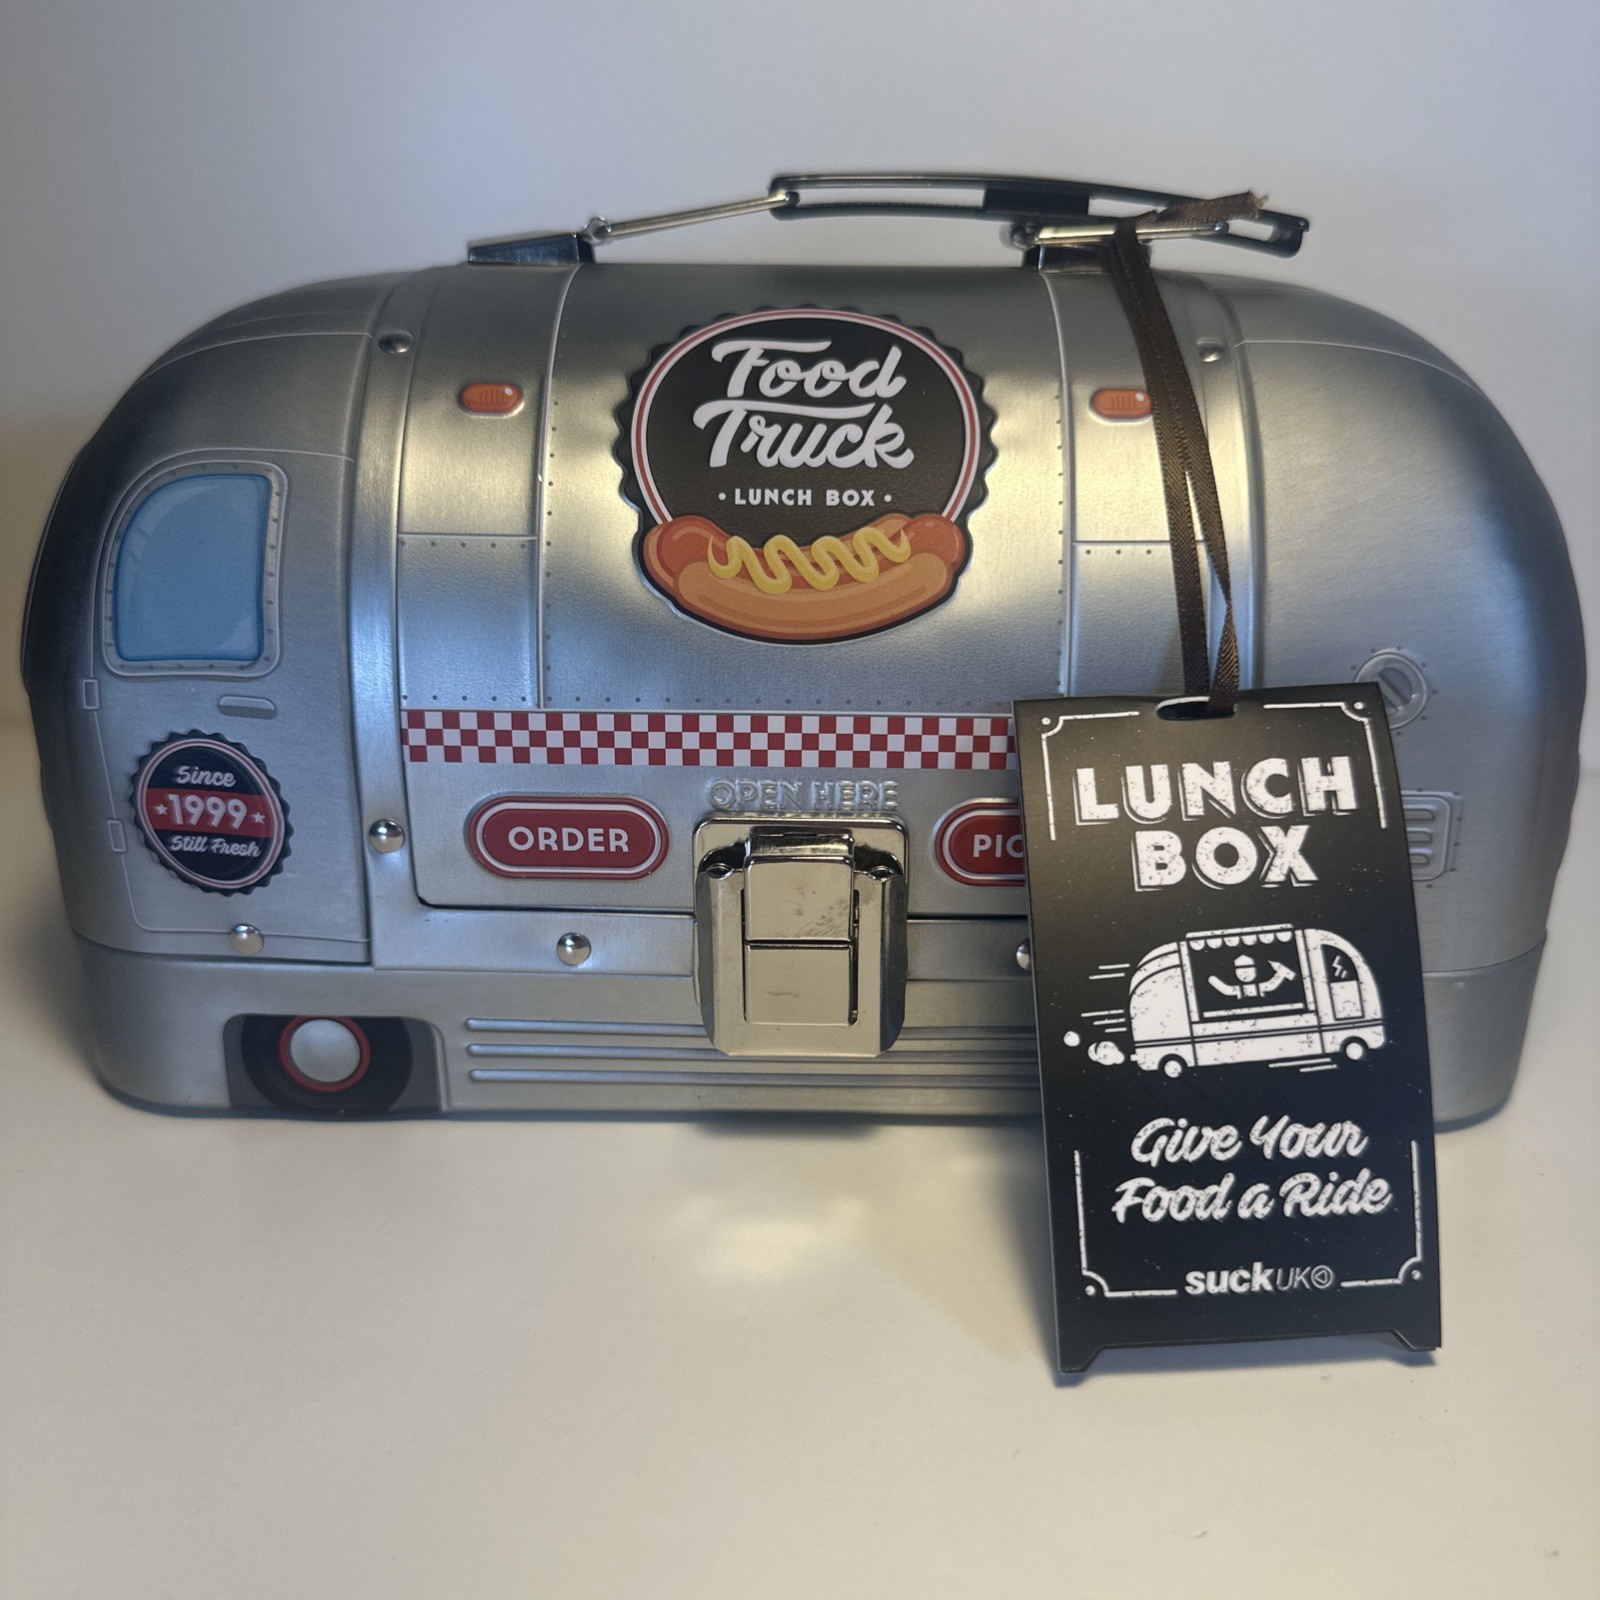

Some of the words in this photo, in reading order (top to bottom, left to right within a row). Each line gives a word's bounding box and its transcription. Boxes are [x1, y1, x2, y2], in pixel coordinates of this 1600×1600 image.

[711, 340, 906, 398] Food
[693, 400, 914, 469] Truck
[735, 489, 812, 506] LUNCH
[826, 489, 875, 507] BOX
[176, 765, 237, 788] Since
[706, 779, 802, 809] OPEN
[811, 779, 900, 810] HERE
[1073, 756, 1357, 826] LUNCH
[167, 794, 248, 830] 1999
[170, 836, 208, 853] Still
[211, 838, 262, 858] Fresh
[507, 826, 630, 853] ORDER
[1131, 824, 1318, 892] BOX
[1131, 1117, 1242, 1167] Give
[1249, 1114, 1369, 1160] Your
[1111, 1172, 1233, 1223] Food
[1237, 1182, 1275, 1219] a
[1279, 1167, 1394, 1218] Ride
